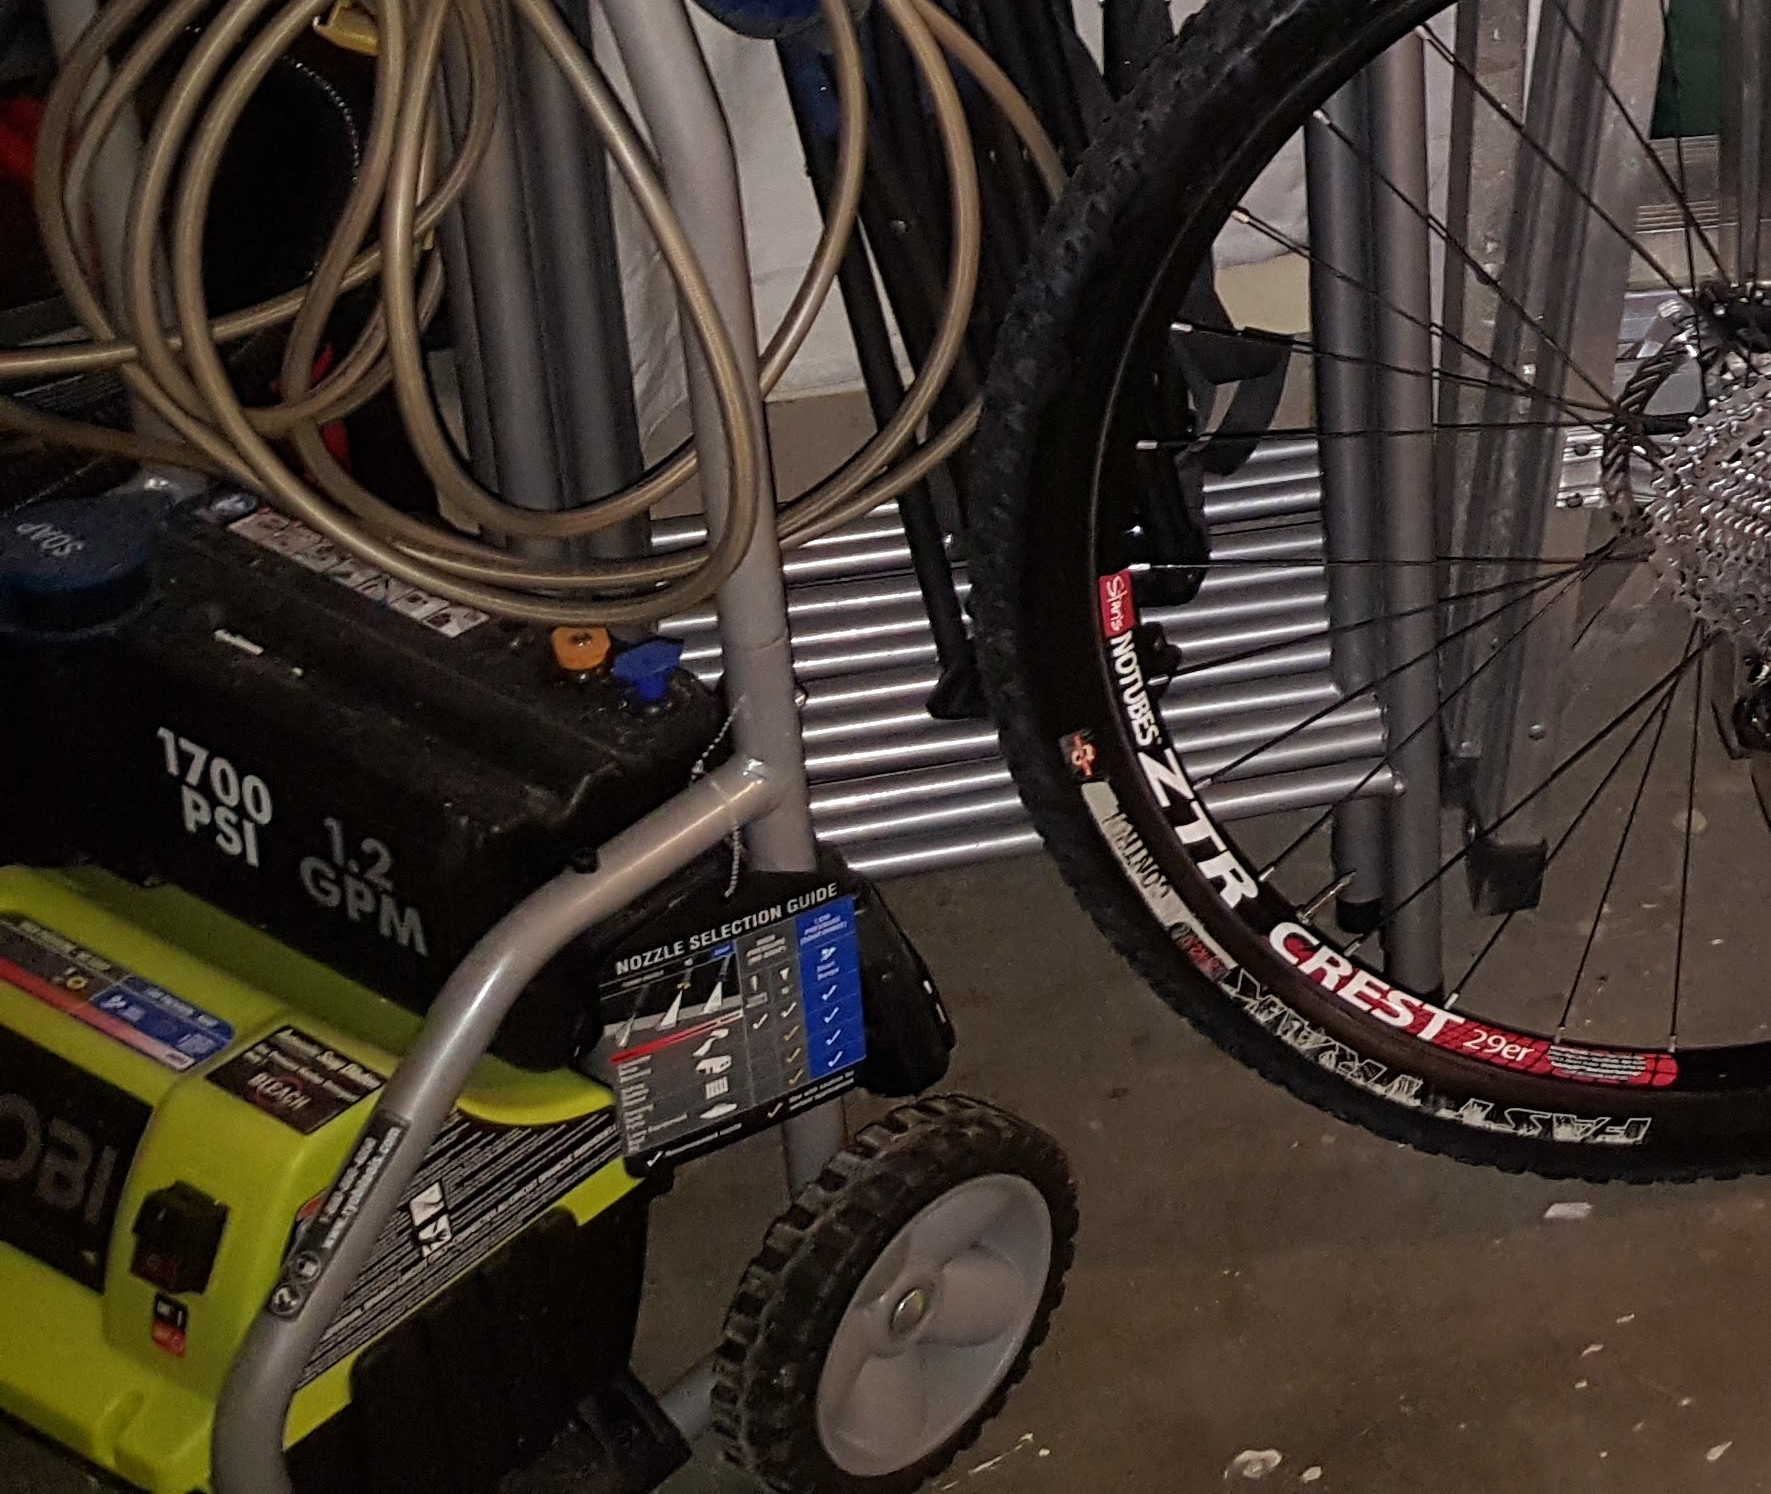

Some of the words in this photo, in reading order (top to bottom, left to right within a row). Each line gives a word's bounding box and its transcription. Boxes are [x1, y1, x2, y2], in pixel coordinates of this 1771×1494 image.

[15, 522, 84, 558] SOAP
[157, 726, 273, 825] 1700
[181, 784, 260, 868] PSI
[323, 815, 394, 893] 1.2
[1109, 629, 1159, 747] NOTUBES
[1137, 747, 1259, 909] ZTR
[1268, 921, 1467, 1042] CREST
[1463, 1028, 1536, 1064] 29er
[300, 856, 430, 957] GPM
[615, 940, 686, 976] NOZZLE
[689, 905, 784, 952] SELECTION
[786, 882, 839, 915] GUIDE
